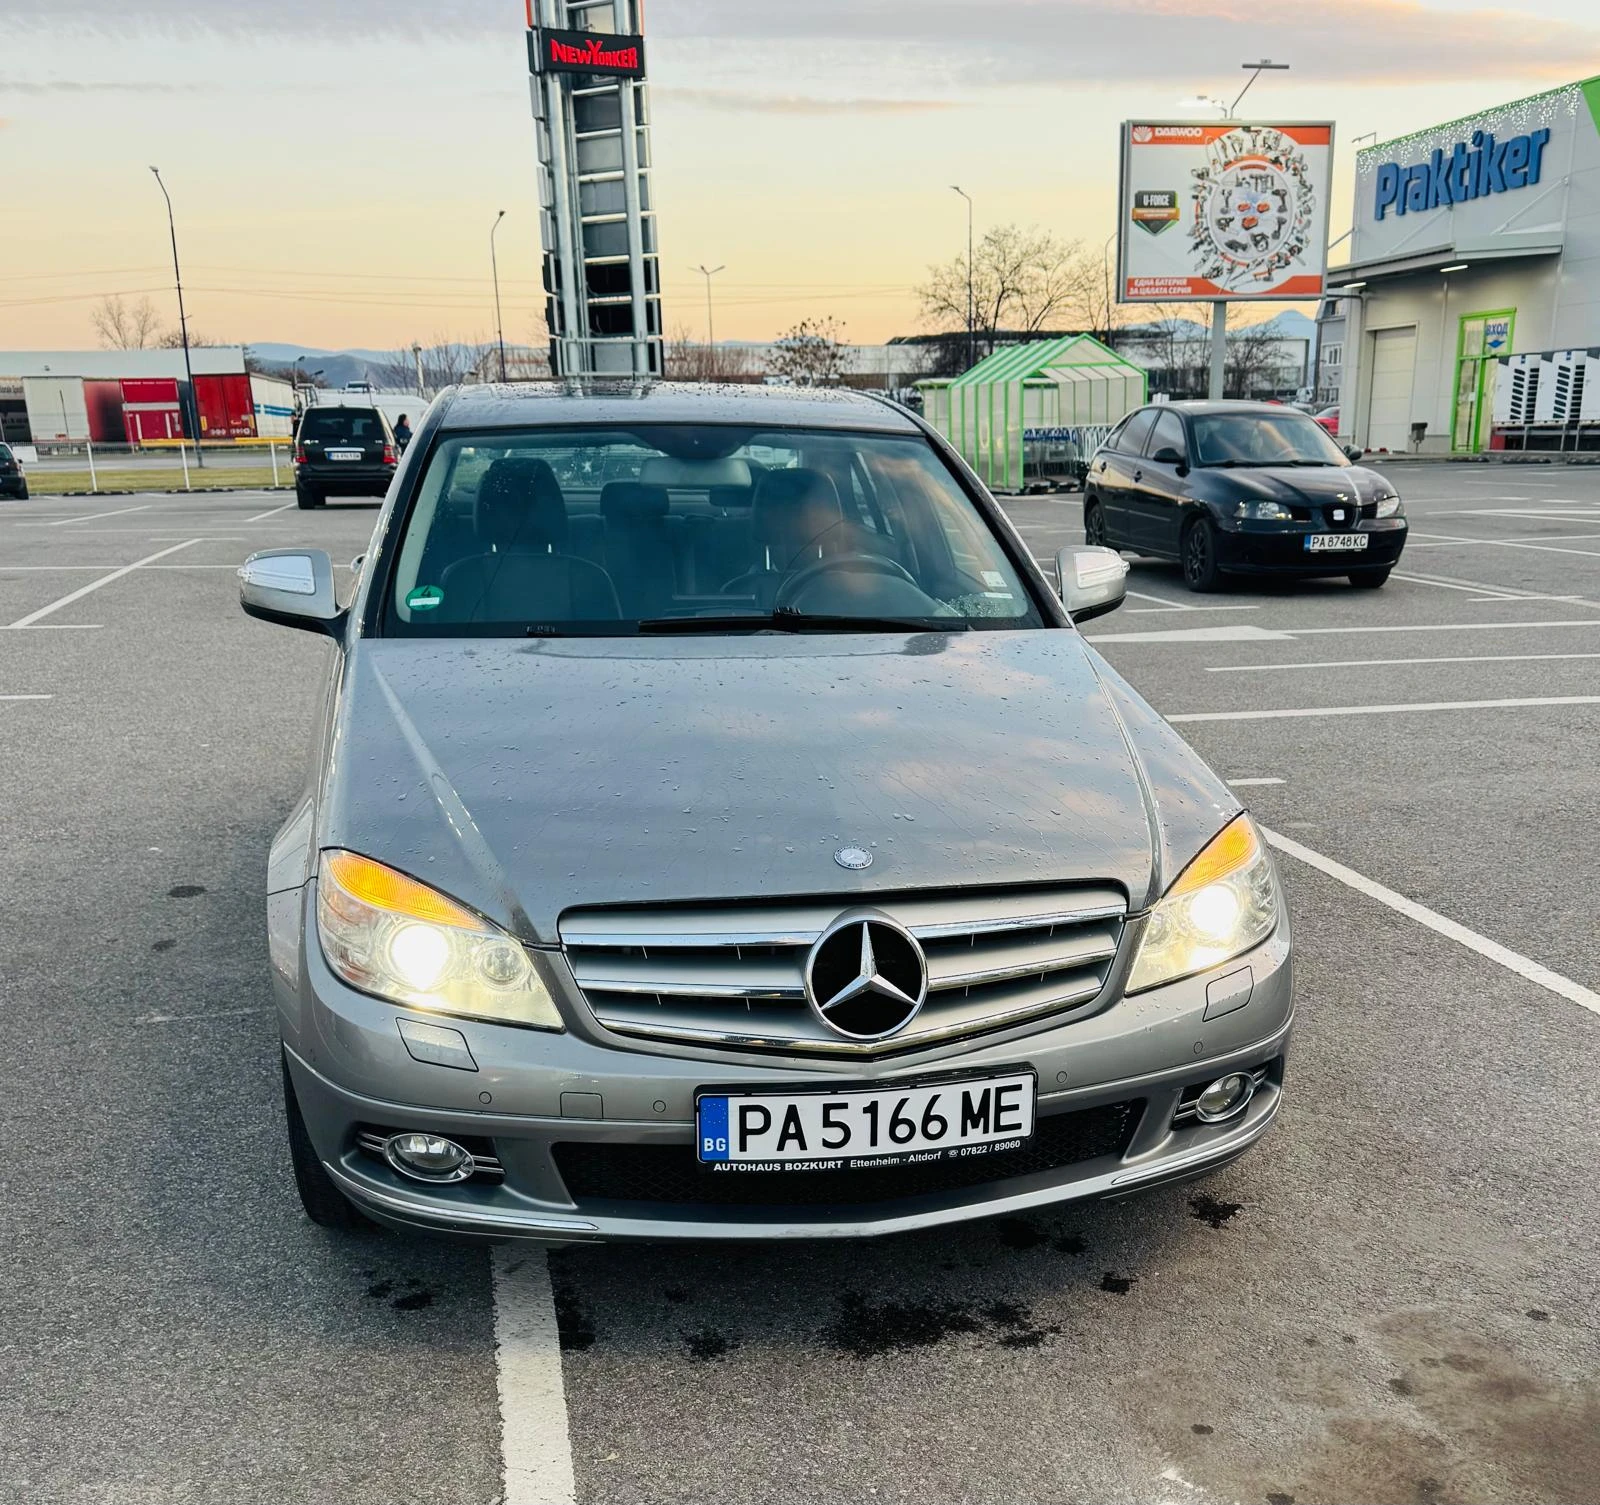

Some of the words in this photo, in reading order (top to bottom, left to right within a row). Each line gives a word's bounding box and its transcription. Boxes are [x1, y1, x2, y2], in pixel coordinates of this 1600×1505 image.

[1155, 127, 1203, 137] DAEWOO
[1374, 127, 1551, 221] Praktiker
[1143, 194, 1169, 206] U-FORCE
[1485, 322, 1508, 336] ВХОД
[1312, 536, 1325, 548] PA
[1327, 536, 1352, 547] 8748
[1353, 535, 1367, 547] KC
[738, 1104, 808, 1152] PA
[821, 1093, 949, 1149] 5166
[960, 1084, 1023, 1138] ME
[703, 1138, 726, 1152] BG
[713, 1163, 782, 1172] AUTOHAUS
[784, 1160, 844, 1171] BOZKURT
[850, 1156, 900, 1168] Ettenheim
[908, 1151, 942, 1163] Altdorf
[960, 1146, 988, 1157] 07822
[994, 1140, 1021, 1151] 89060
